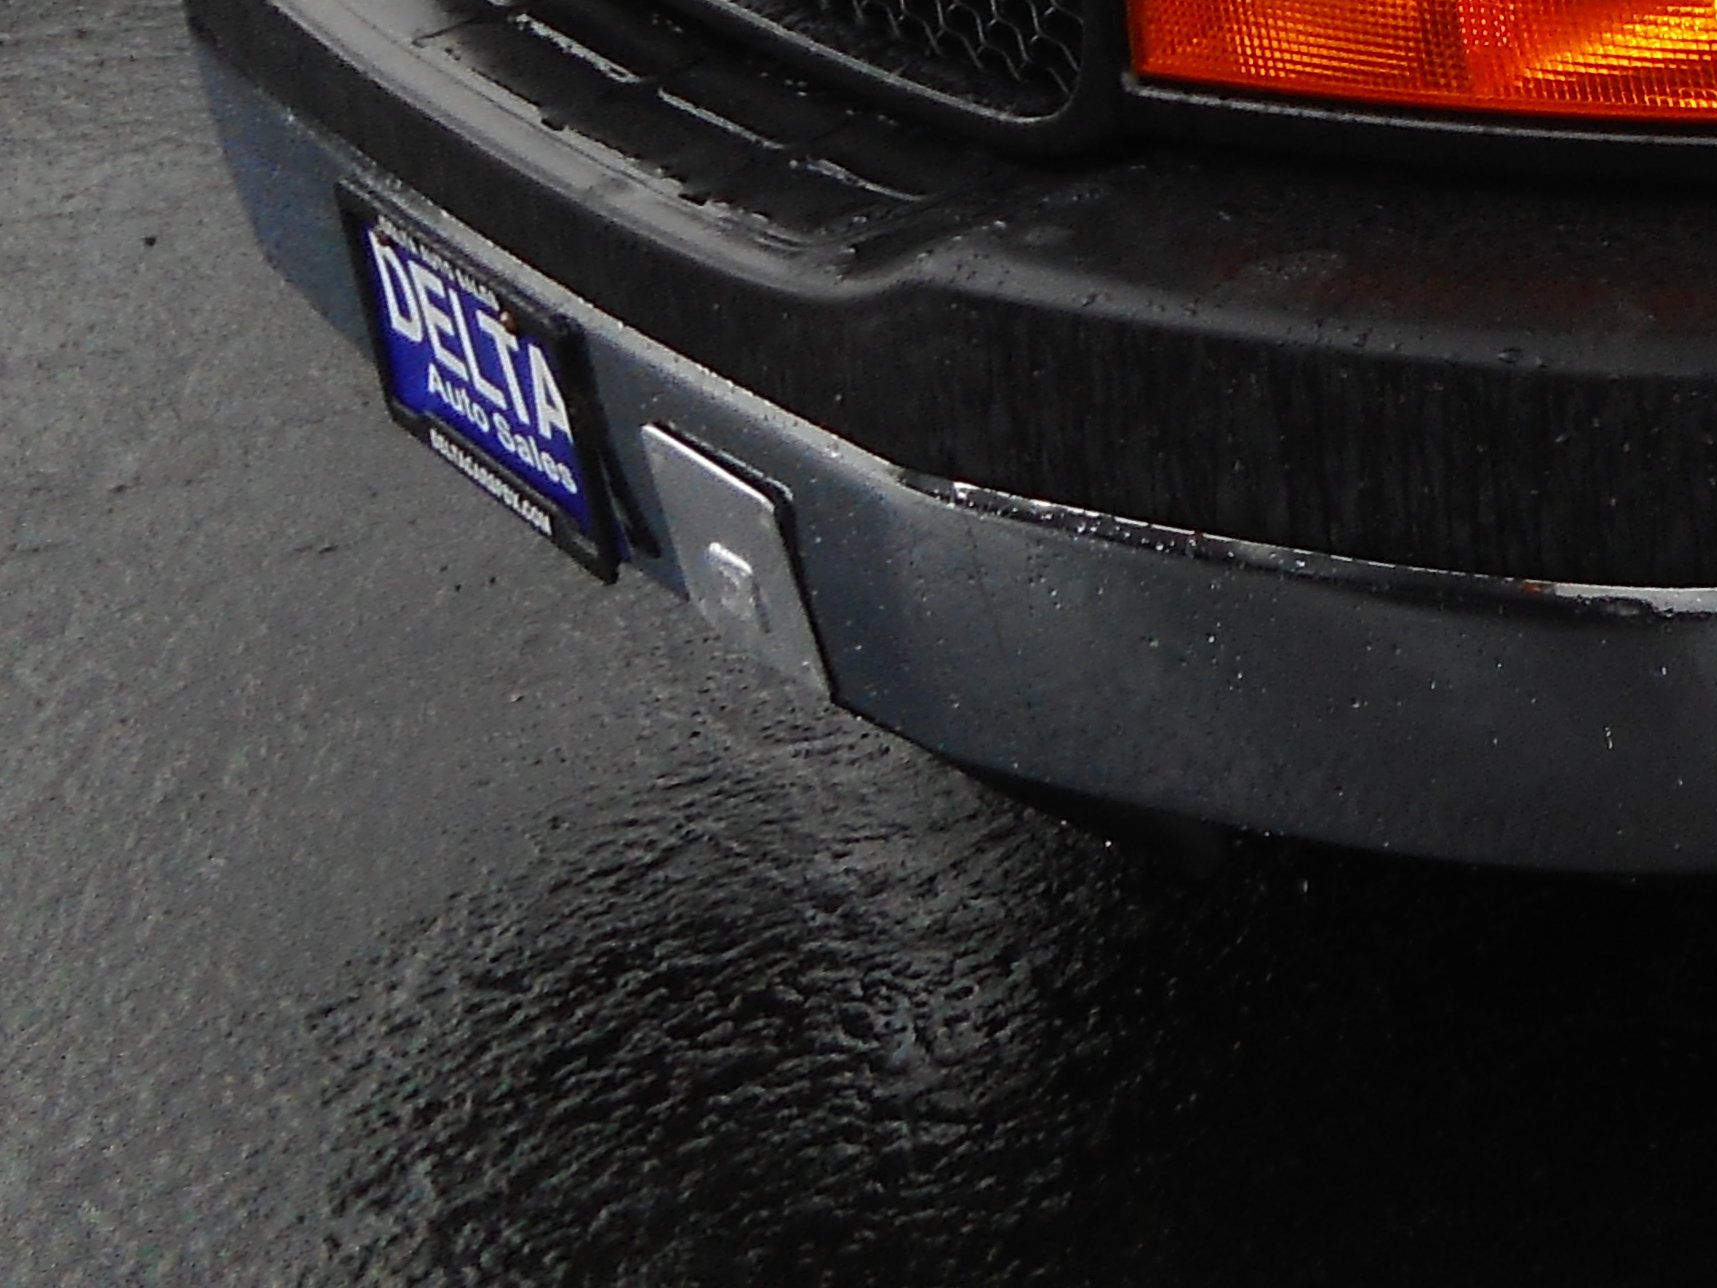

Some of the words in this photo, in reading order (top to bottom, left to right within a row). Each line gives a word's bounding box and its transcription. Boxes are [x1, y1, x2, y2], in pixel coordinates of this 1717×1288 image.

[368, 230, 573, 444] DELTA
[428, 363, 490, 433] Auto
[492, 412, 588, 495] Sales
